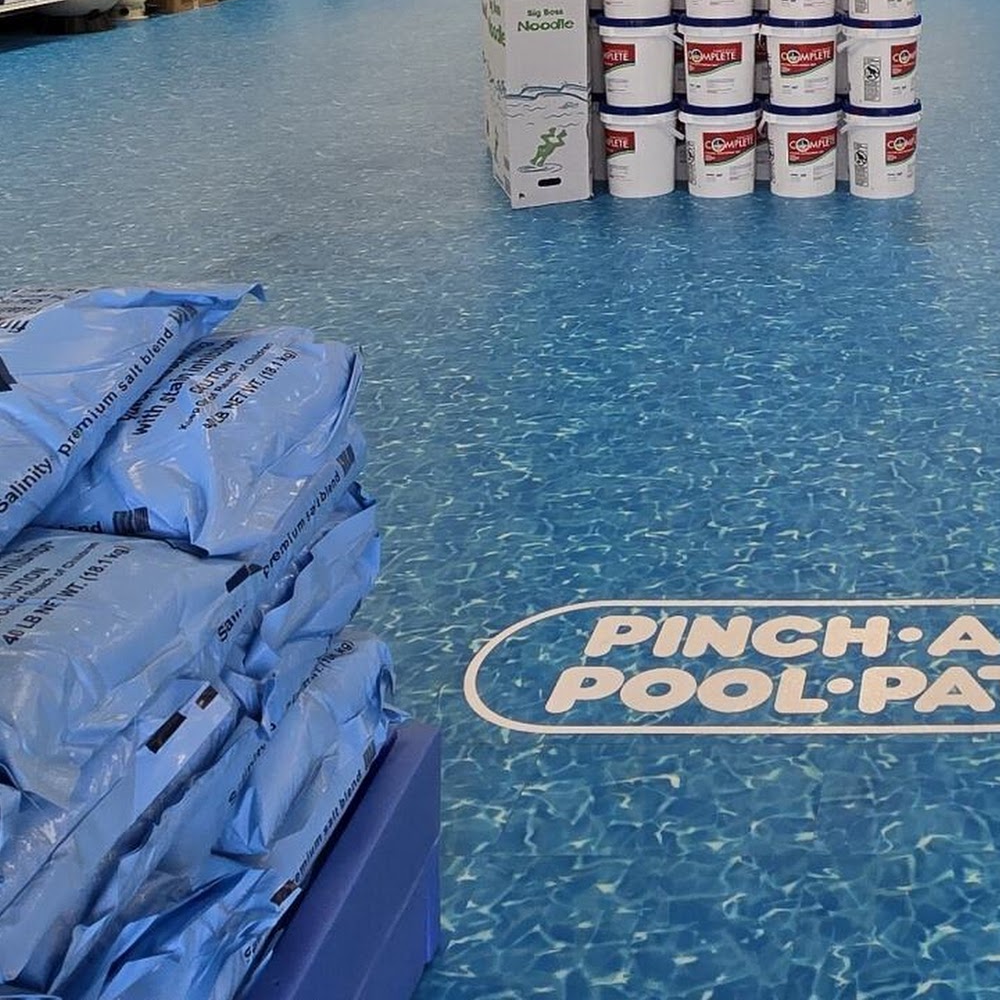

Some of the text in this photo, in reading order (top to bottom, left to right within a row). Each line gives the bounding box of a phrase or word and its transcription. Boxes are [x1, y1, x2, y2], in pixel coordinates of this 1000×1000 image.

[517, 18, 575, 32] Noodle
[527, 8, 564, 18] Big Boss
[688, 49, 736, 63] COMPLETE
[781, 49, 831, 64] COMPLETE
[58, 390, 118, 458] premium
[118, 363, 143, 392] salt
[140, 328, 174, 366] blend
[132, 403, 167, 436] with
[160, 369, 194, 403] stain
[223, 389, 249, 410] NET
[263, 517, 305, 579] premium
[0, 568, 50, 599] AUTION
[2, 628, 25, 646] 40
[16, 614, 43, 629] LB
[56, 582, 89, 602] WT.
[79, 557, 114, 582] (18.1
